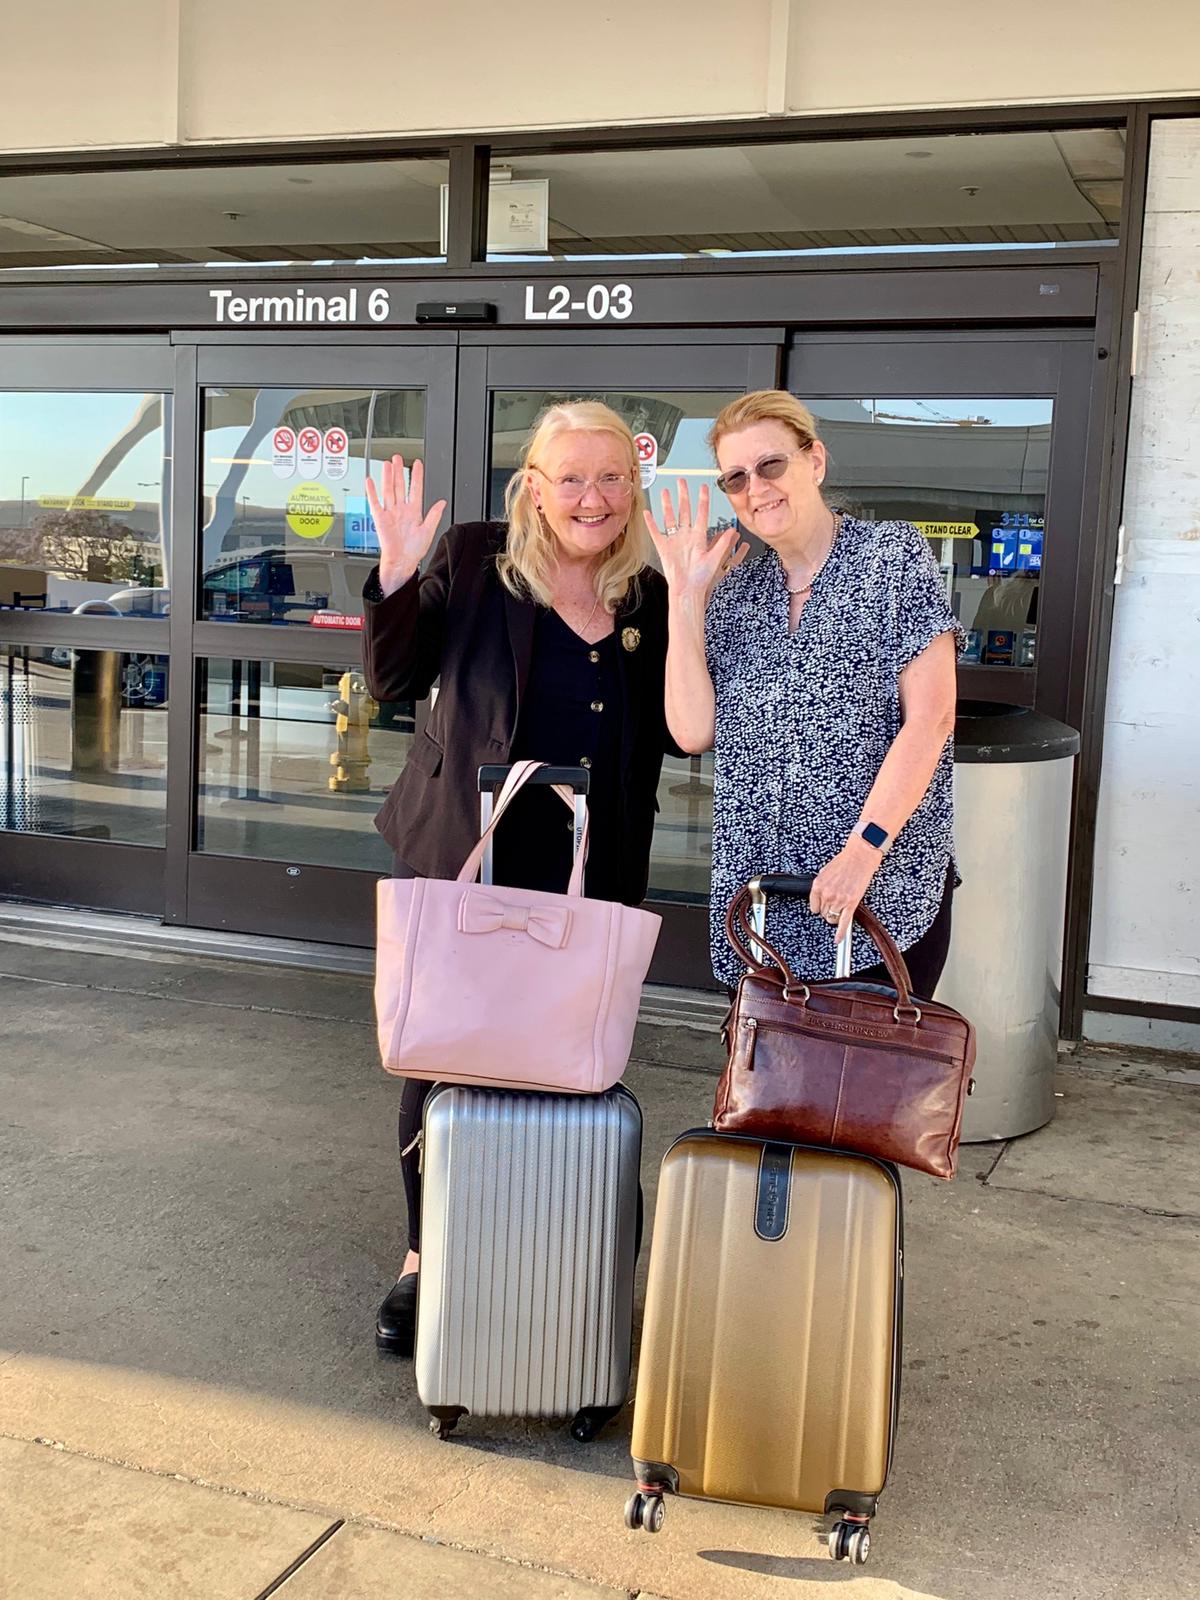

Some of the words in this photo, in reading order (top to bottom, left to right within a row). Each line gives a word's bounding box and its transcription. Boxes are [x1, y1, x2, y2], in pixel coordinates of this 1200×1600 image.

[209, 288, 357, 322] Terminal
[368, 288, 390, 322] 6
[524, 284, 634, 320] L2-03
[291, 494, 330, 503] AUTOMATIC
[288, 503, 332, 515] CAUTION
[924, 525, 948, 535] STAND
[949, 526, 972, 535] CLEAR
[313, 615, 345, 625] AUTOMATIC
[345, 617, 361, 625] DOOR
